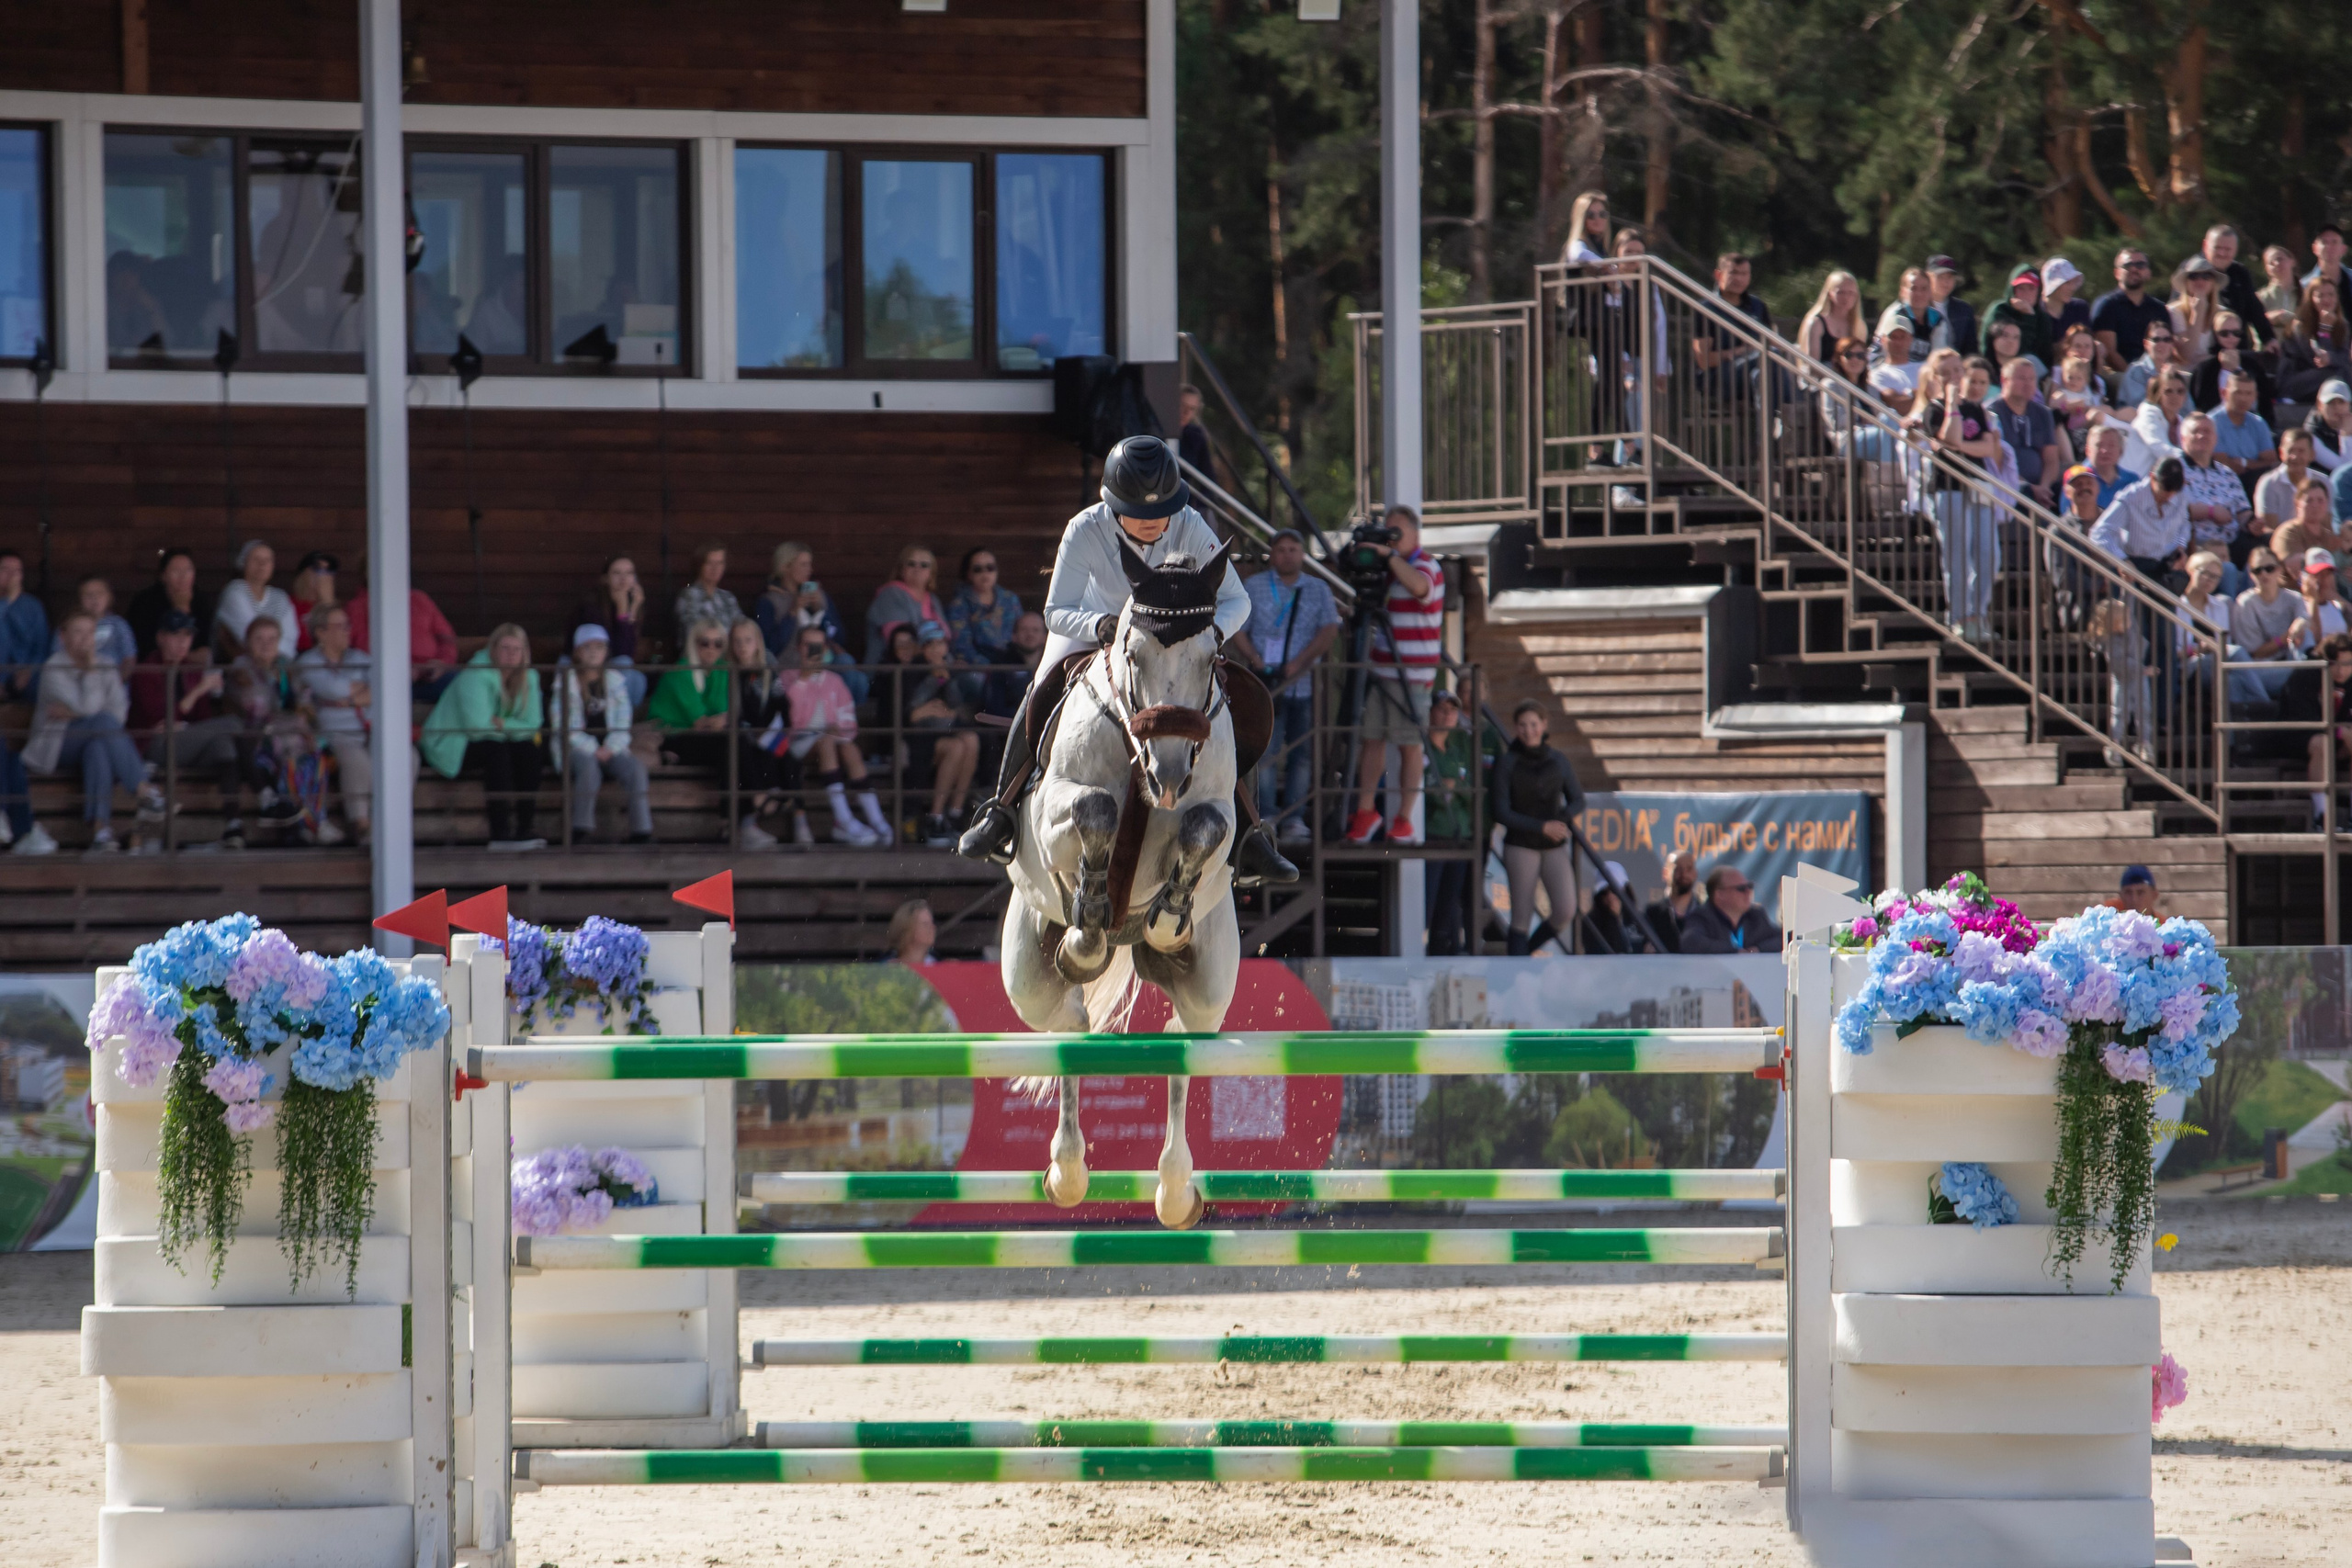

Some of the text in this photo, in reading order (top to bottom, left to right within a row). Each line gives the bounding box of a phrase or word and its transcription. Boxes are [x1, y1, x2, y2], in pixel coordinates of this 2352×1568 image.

[1674, 812, 1758, 860] будьте
[1763, 820, 1780, 852] с
[1785, 809, 1858, 852] нами!
